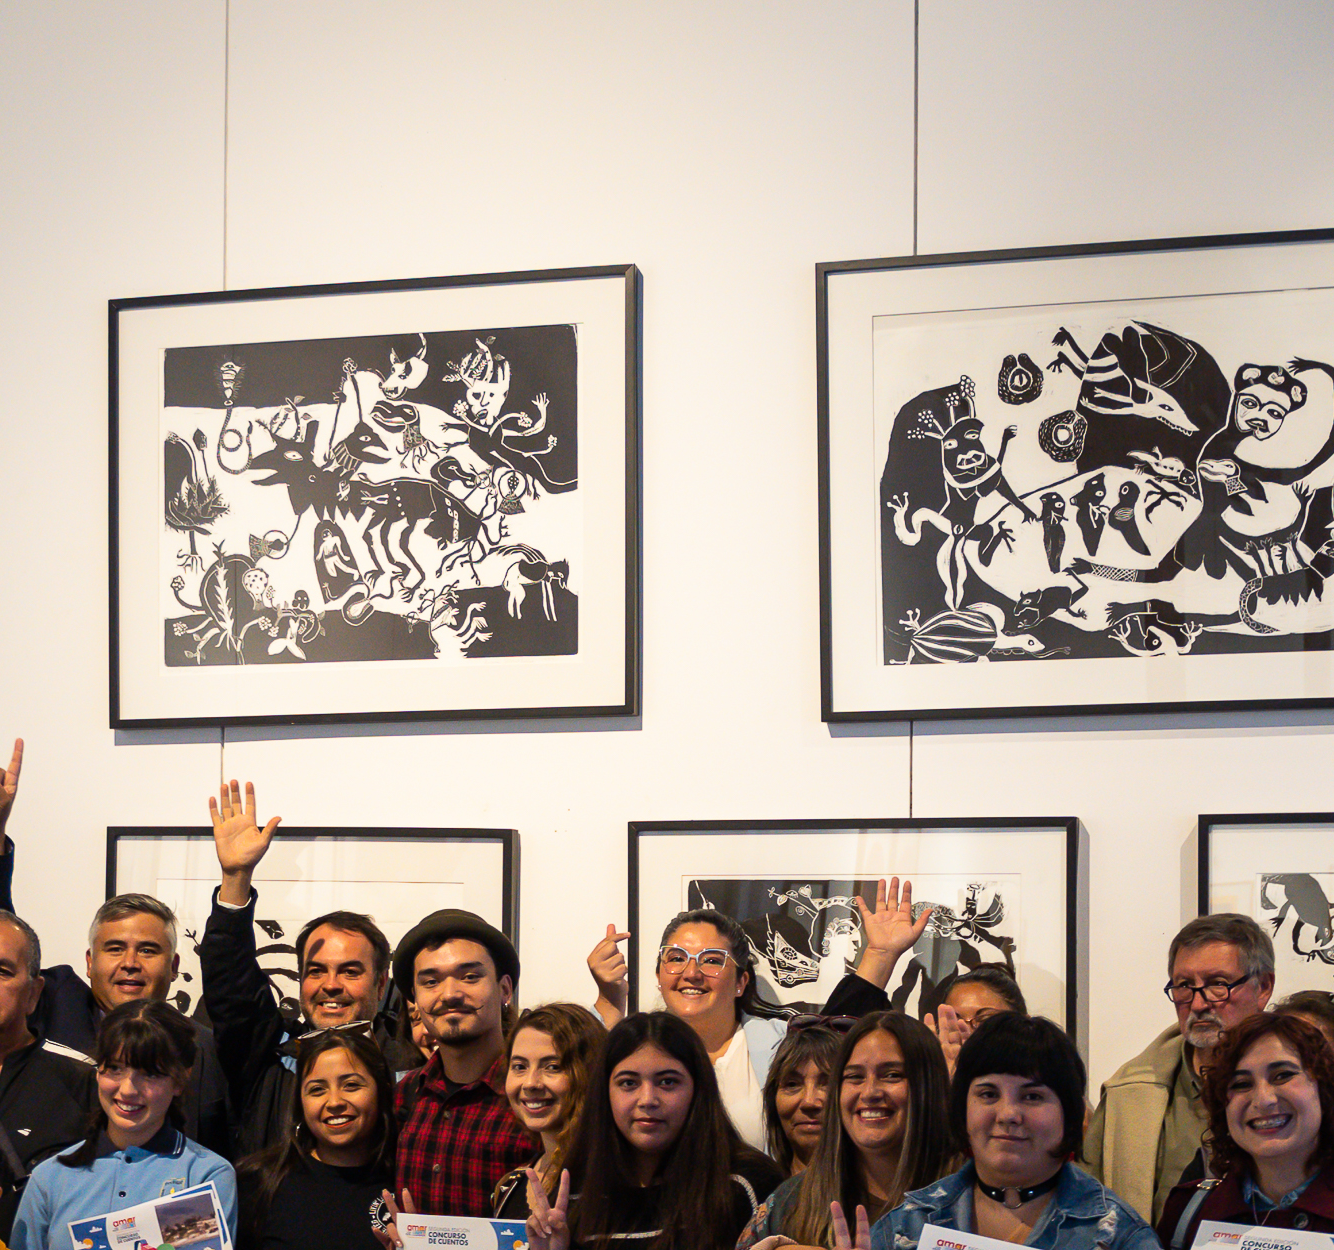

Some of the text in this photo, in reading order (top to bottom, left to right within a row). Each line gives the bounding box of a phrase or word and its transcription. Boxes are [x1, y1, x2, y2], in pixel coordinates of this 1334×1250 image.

[113, 1217, 136, 1228] amar
[1213, 1231, 1243, 1240] amar
[438, 1238, 469, 1246] CUENTOS
[937, 1239, 967, 1250] amar
